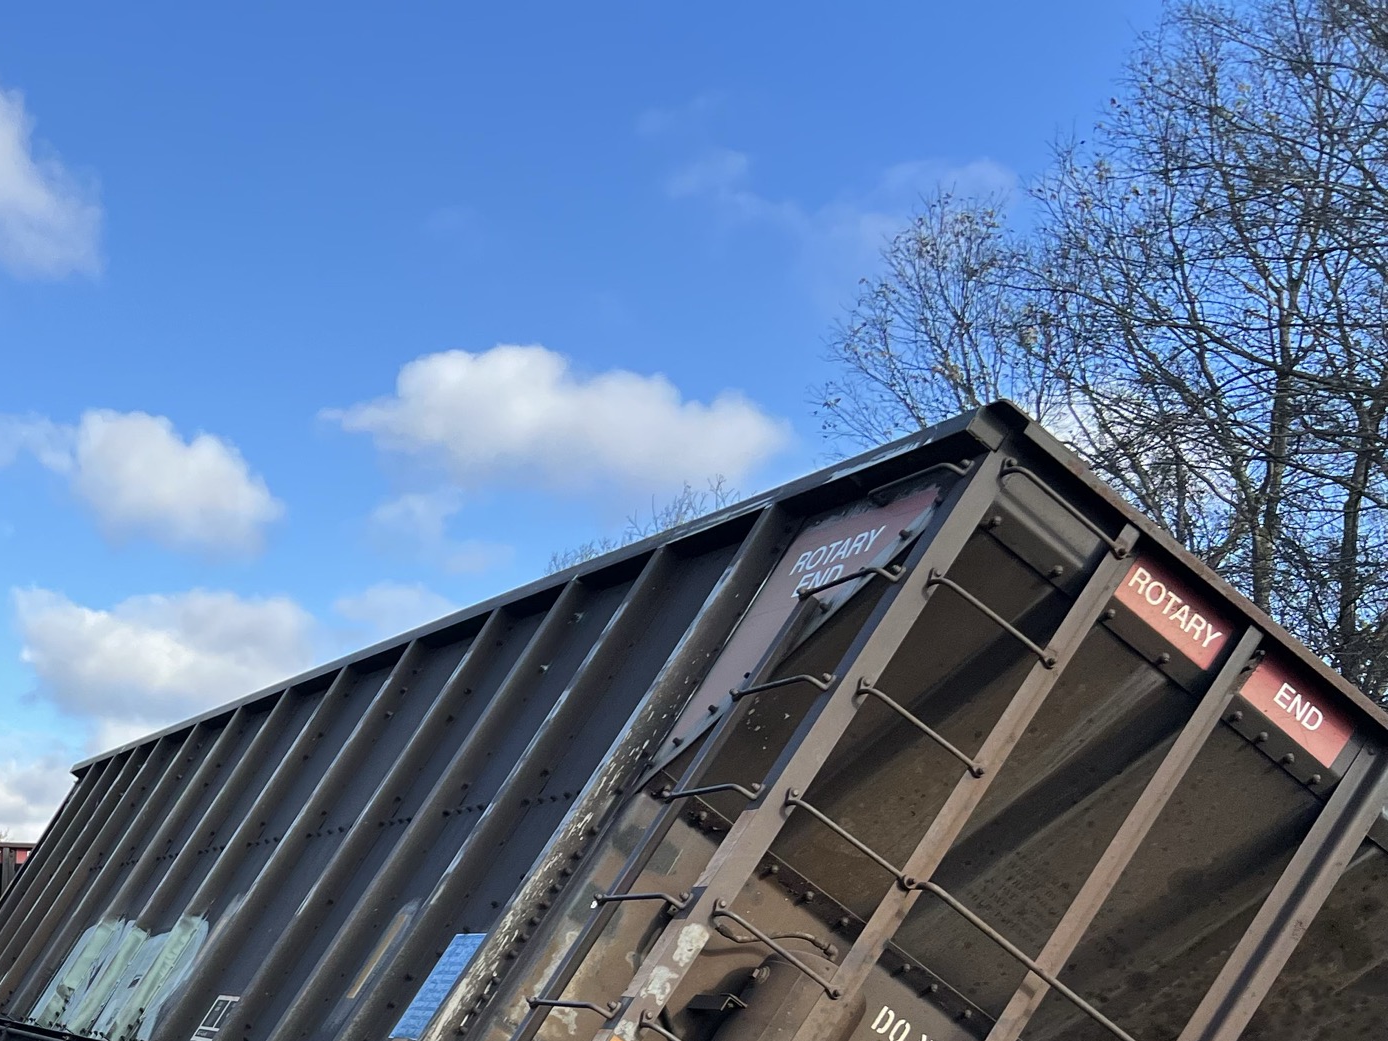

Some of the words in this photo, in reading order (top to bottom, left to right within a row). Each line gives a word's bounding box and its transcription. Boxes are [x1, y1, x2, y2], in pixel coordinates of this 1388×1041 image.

[789, 525, 887, 576] ROTARY
[790, 564, 844, 598] END
[1128, 567, 1223, 648] ROTARY
[1273, 682, 1324, 731] END
